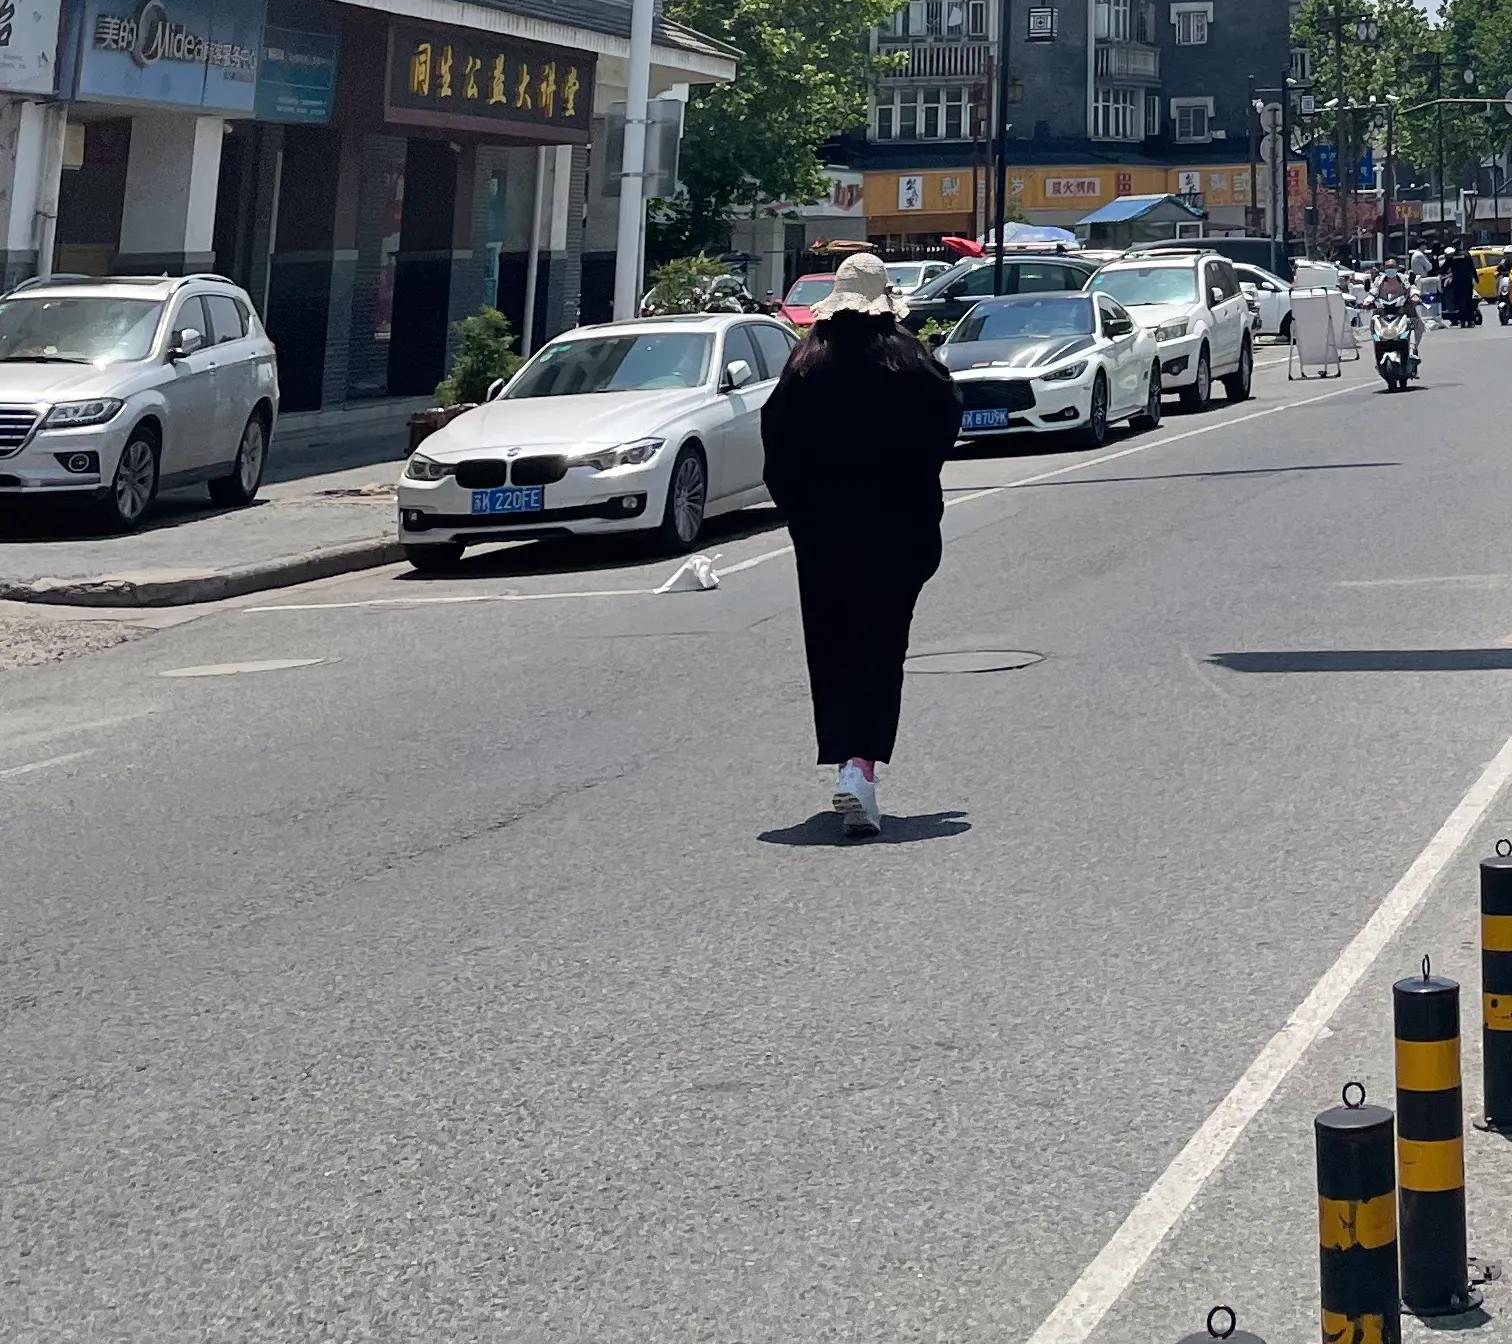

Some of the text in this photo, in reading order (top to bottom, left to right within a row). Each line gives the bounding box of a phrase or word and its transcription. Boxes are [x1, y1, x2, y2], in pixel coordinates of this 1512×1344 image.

[96, 16, 137, 51] 美的
[141, 12, 208, 64] Midea
[410, 43, 580, 117] 同生公益大讲堂
